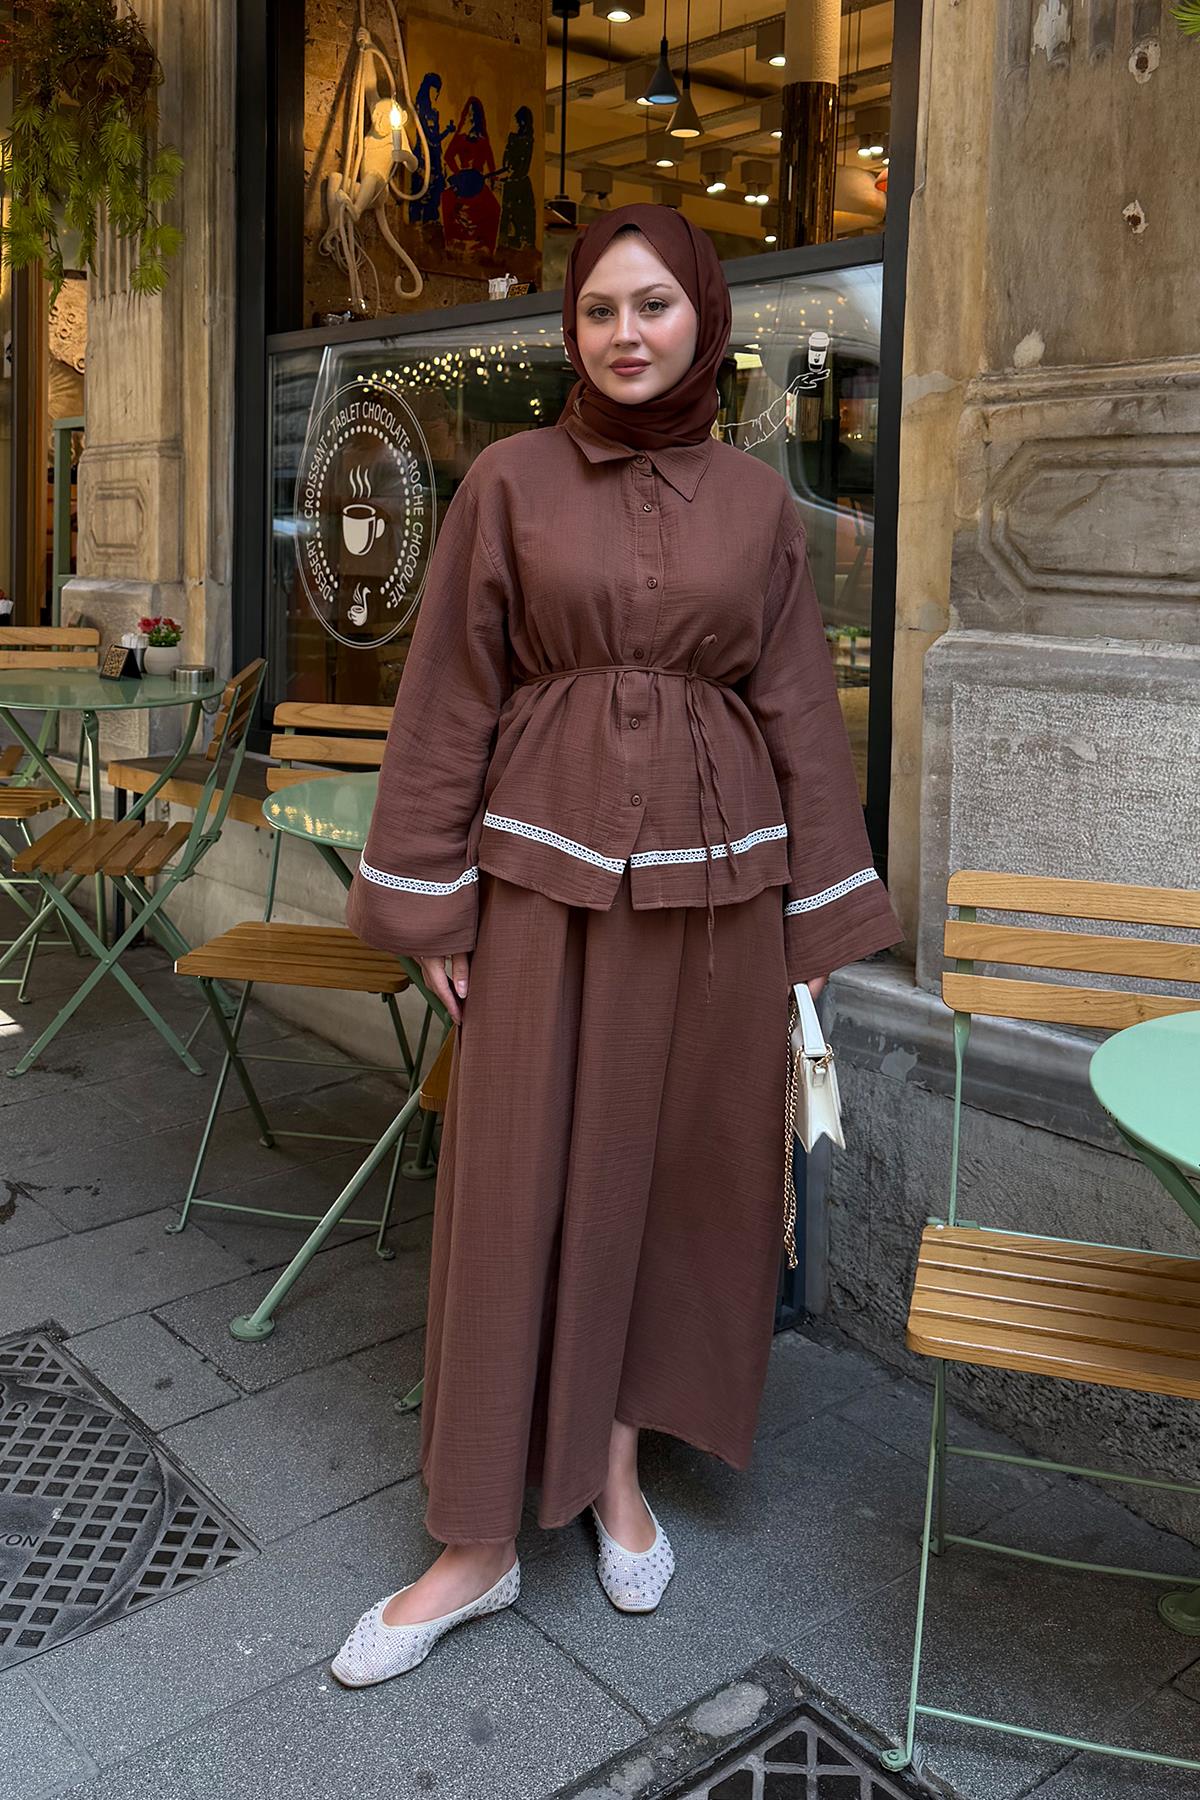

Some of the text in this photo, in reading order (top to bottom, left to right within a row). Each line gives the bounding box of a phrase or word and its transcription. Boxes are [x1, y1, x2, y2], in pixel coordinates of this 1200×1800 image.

[304, 401, 424, 608] DESSERT CROISSANT TABLET CHOCOLATE ROCHE CHOCOLATE
